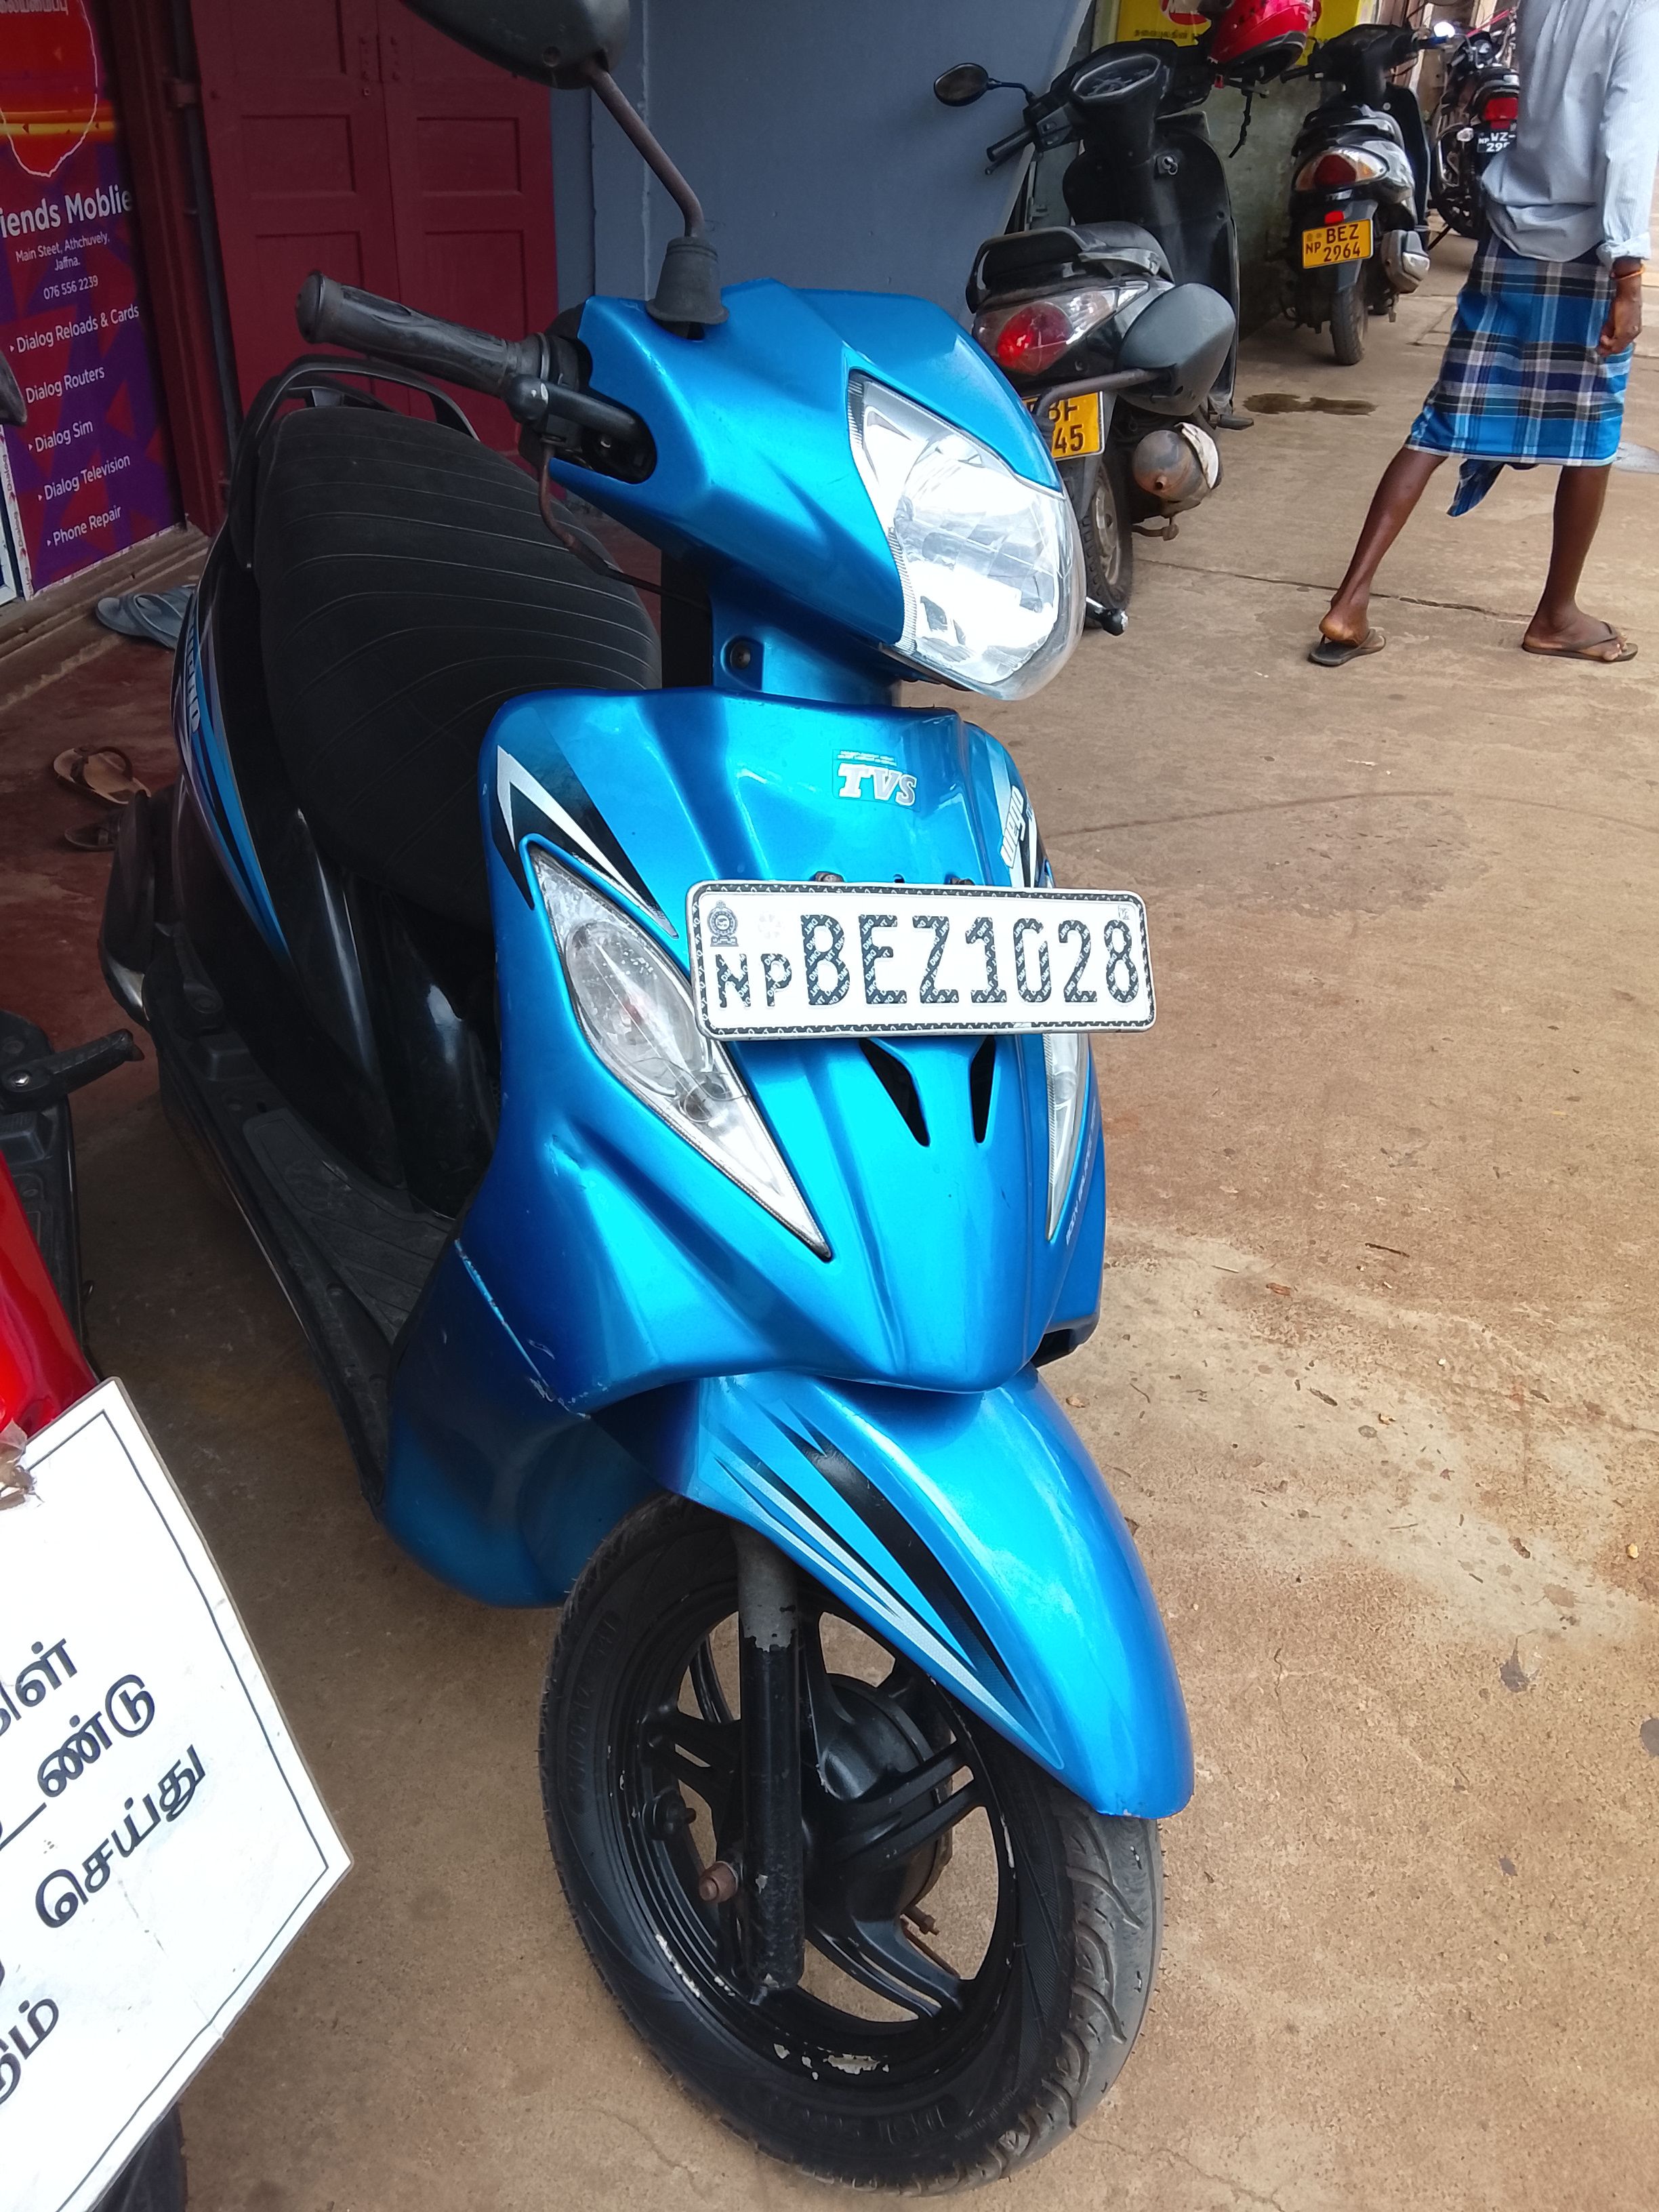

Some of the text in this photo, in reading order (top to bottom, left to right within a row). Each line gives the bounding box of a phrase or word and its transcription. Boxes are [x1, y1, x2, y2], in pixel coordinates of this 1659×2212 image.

[0, 184, 133, 238] iends Moblie
[1305, 241, 1361, 263] NP 2964
[1326, 223, 1359, 245] BEZ
[16, 249, 37, 263] Main
[54, 255, 81, 271] Jaffna.
[43, 274, 98, 300] 076 556 2239
[16, 304, 140, 353] Dialog Reloads & Cards
[25, 367, 105, 404] Dialog Routers
[35, 420, 94, 453] Dialog Sim
[1054, 424, 1084, 454] 45
[43, 455, 131, 501] Dialog Television
[53, 505, 121, 546] Phone Repair
[838, 762, 918, 806] TVS
[715, 914, 1141, 1008] NP BEZ1028
[35, 1744, 206, 1929] செய்து
